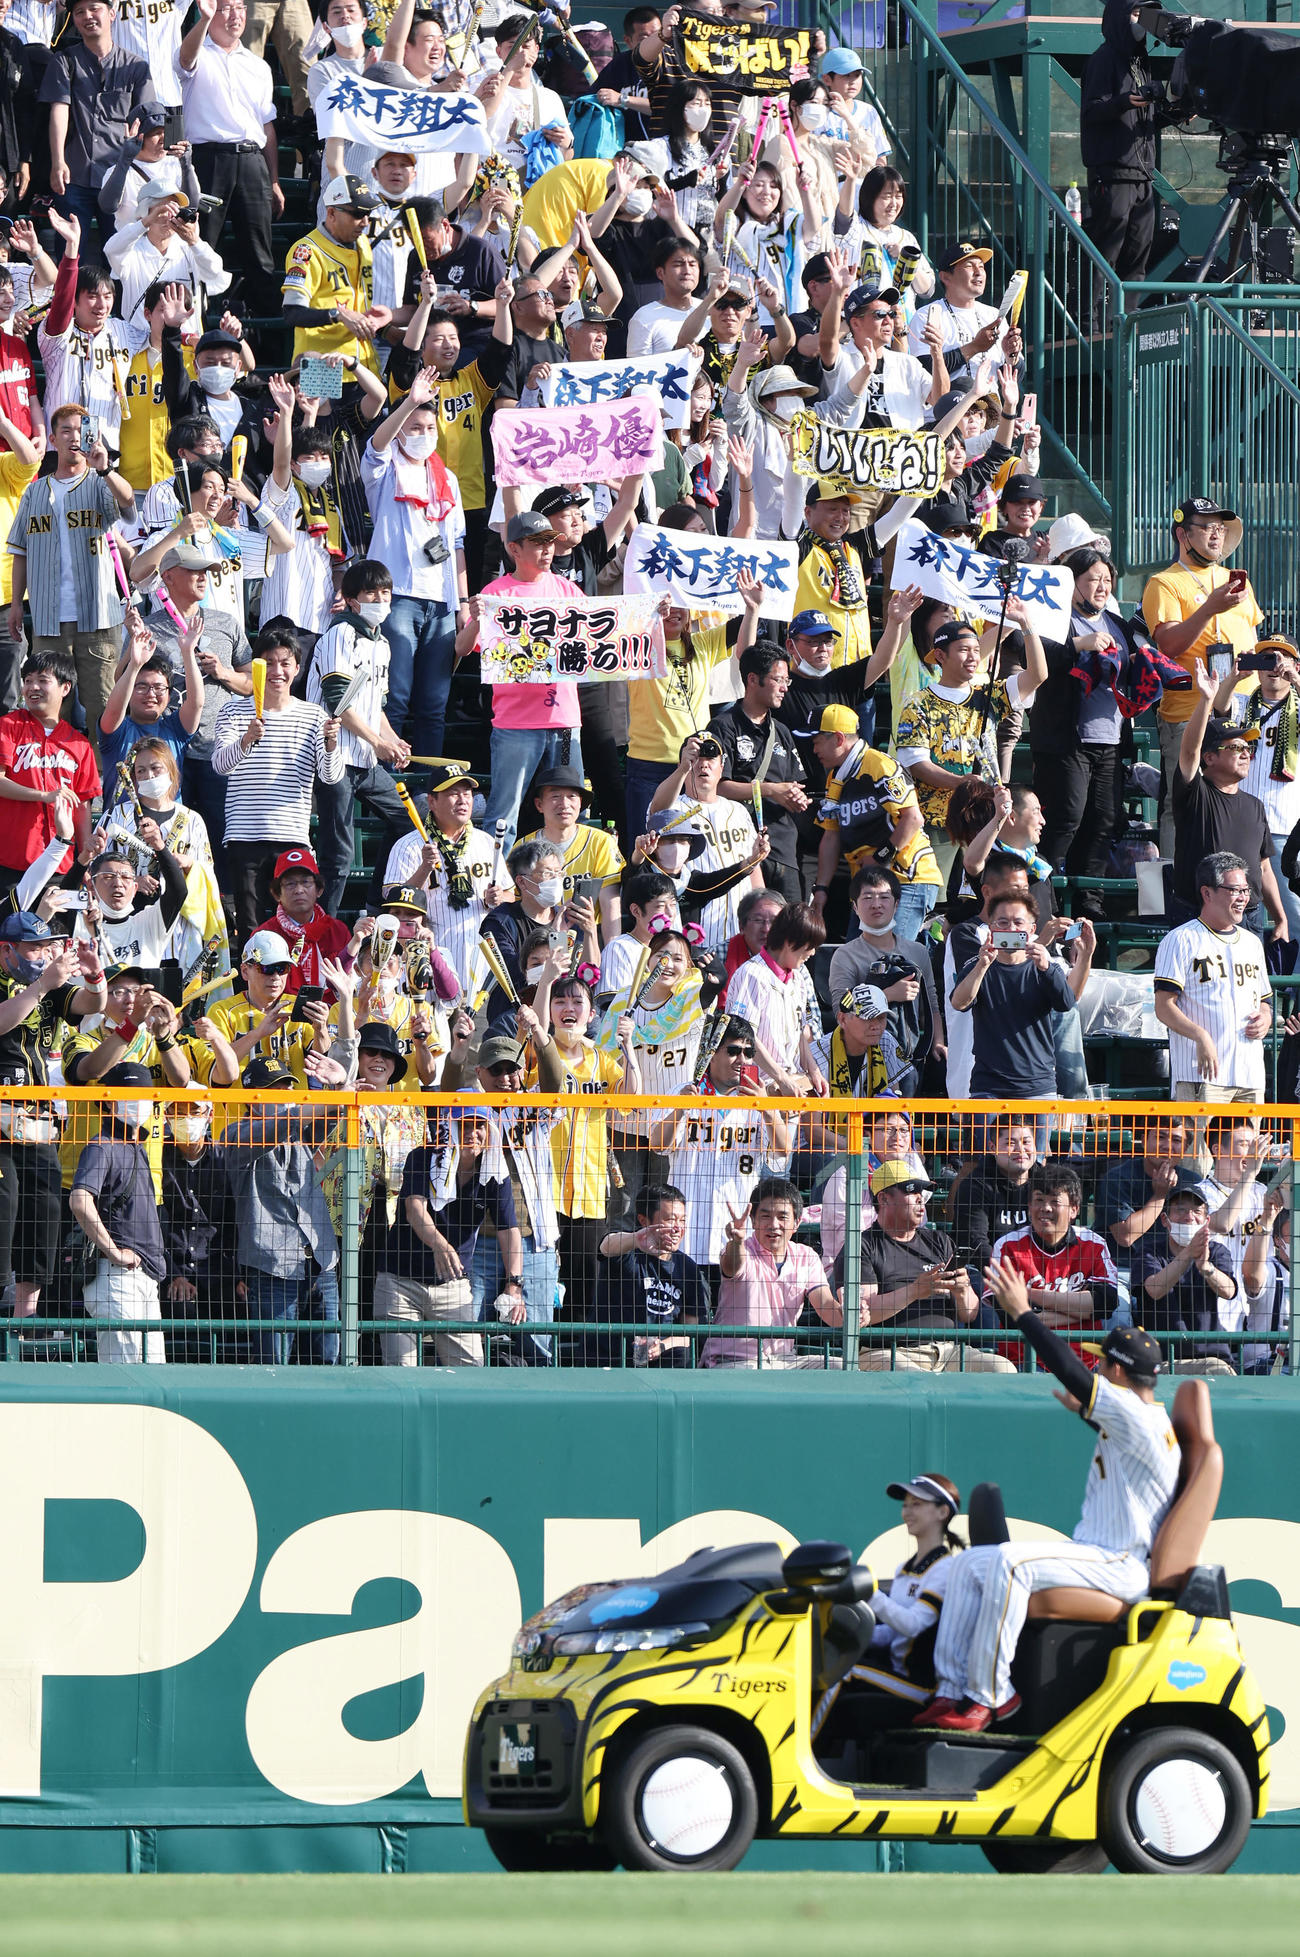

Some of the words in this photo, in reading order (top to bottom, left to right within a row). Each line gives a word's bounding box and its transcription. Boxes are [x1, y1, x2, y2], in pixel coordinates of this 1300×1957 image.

[327, 75, 481, 133] 森下翔太
[509, 406, 657, 469] 岩崎優
[634, 532, 791, 593] 森下翔太
[497, 608, 616, 639] サヨナラ
[558, 635, 651, 672] 勝ち!!!
[663, 1048, 687, 1068] 27
[739, 1154, 754, 1175] 8
[711, 1672, 787, 1699] Tigers
[499, 1736, 535, 1769] Tigers
